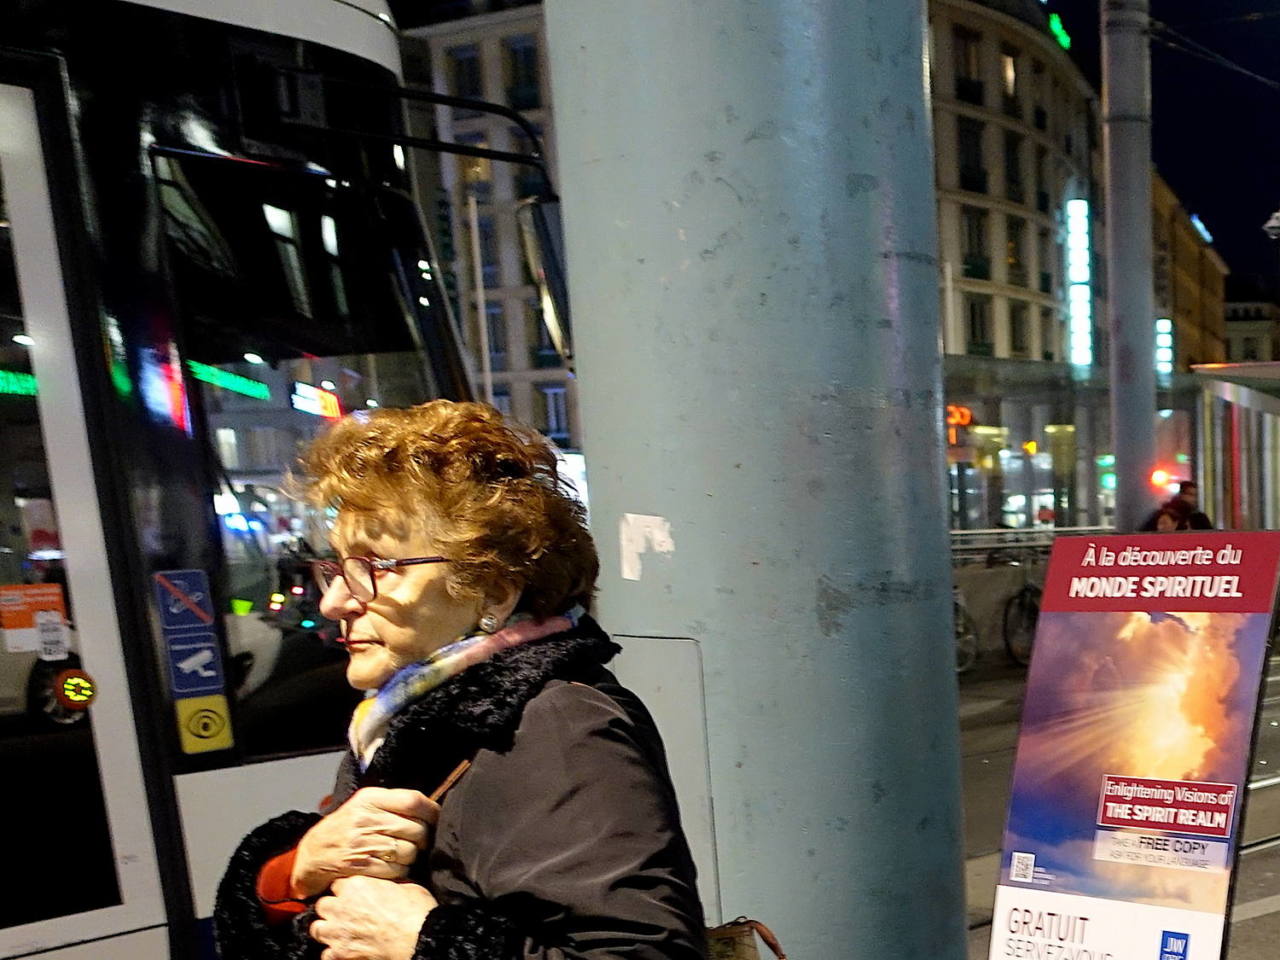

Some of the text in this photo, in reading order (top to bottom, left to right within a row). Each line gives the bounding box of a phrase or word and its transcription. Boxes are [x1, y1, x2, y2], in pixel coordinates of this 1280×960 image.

[1081, 543, 1242, 567] À la découverte du
[1069, 576, 1243, 598] MONDE SPIRITUEL
[1105, 781, 1234, 806] Enlightening Visions of
[1105, 802, 1227, 829] THE SPIRIT REALM
[1139, 836, 1171, 852] FREE
[1173, 839, 1209, 856] COPY
[1008, 907, 1090, 944] GRATUIT
[1164, 937, 1186, 954] JW
